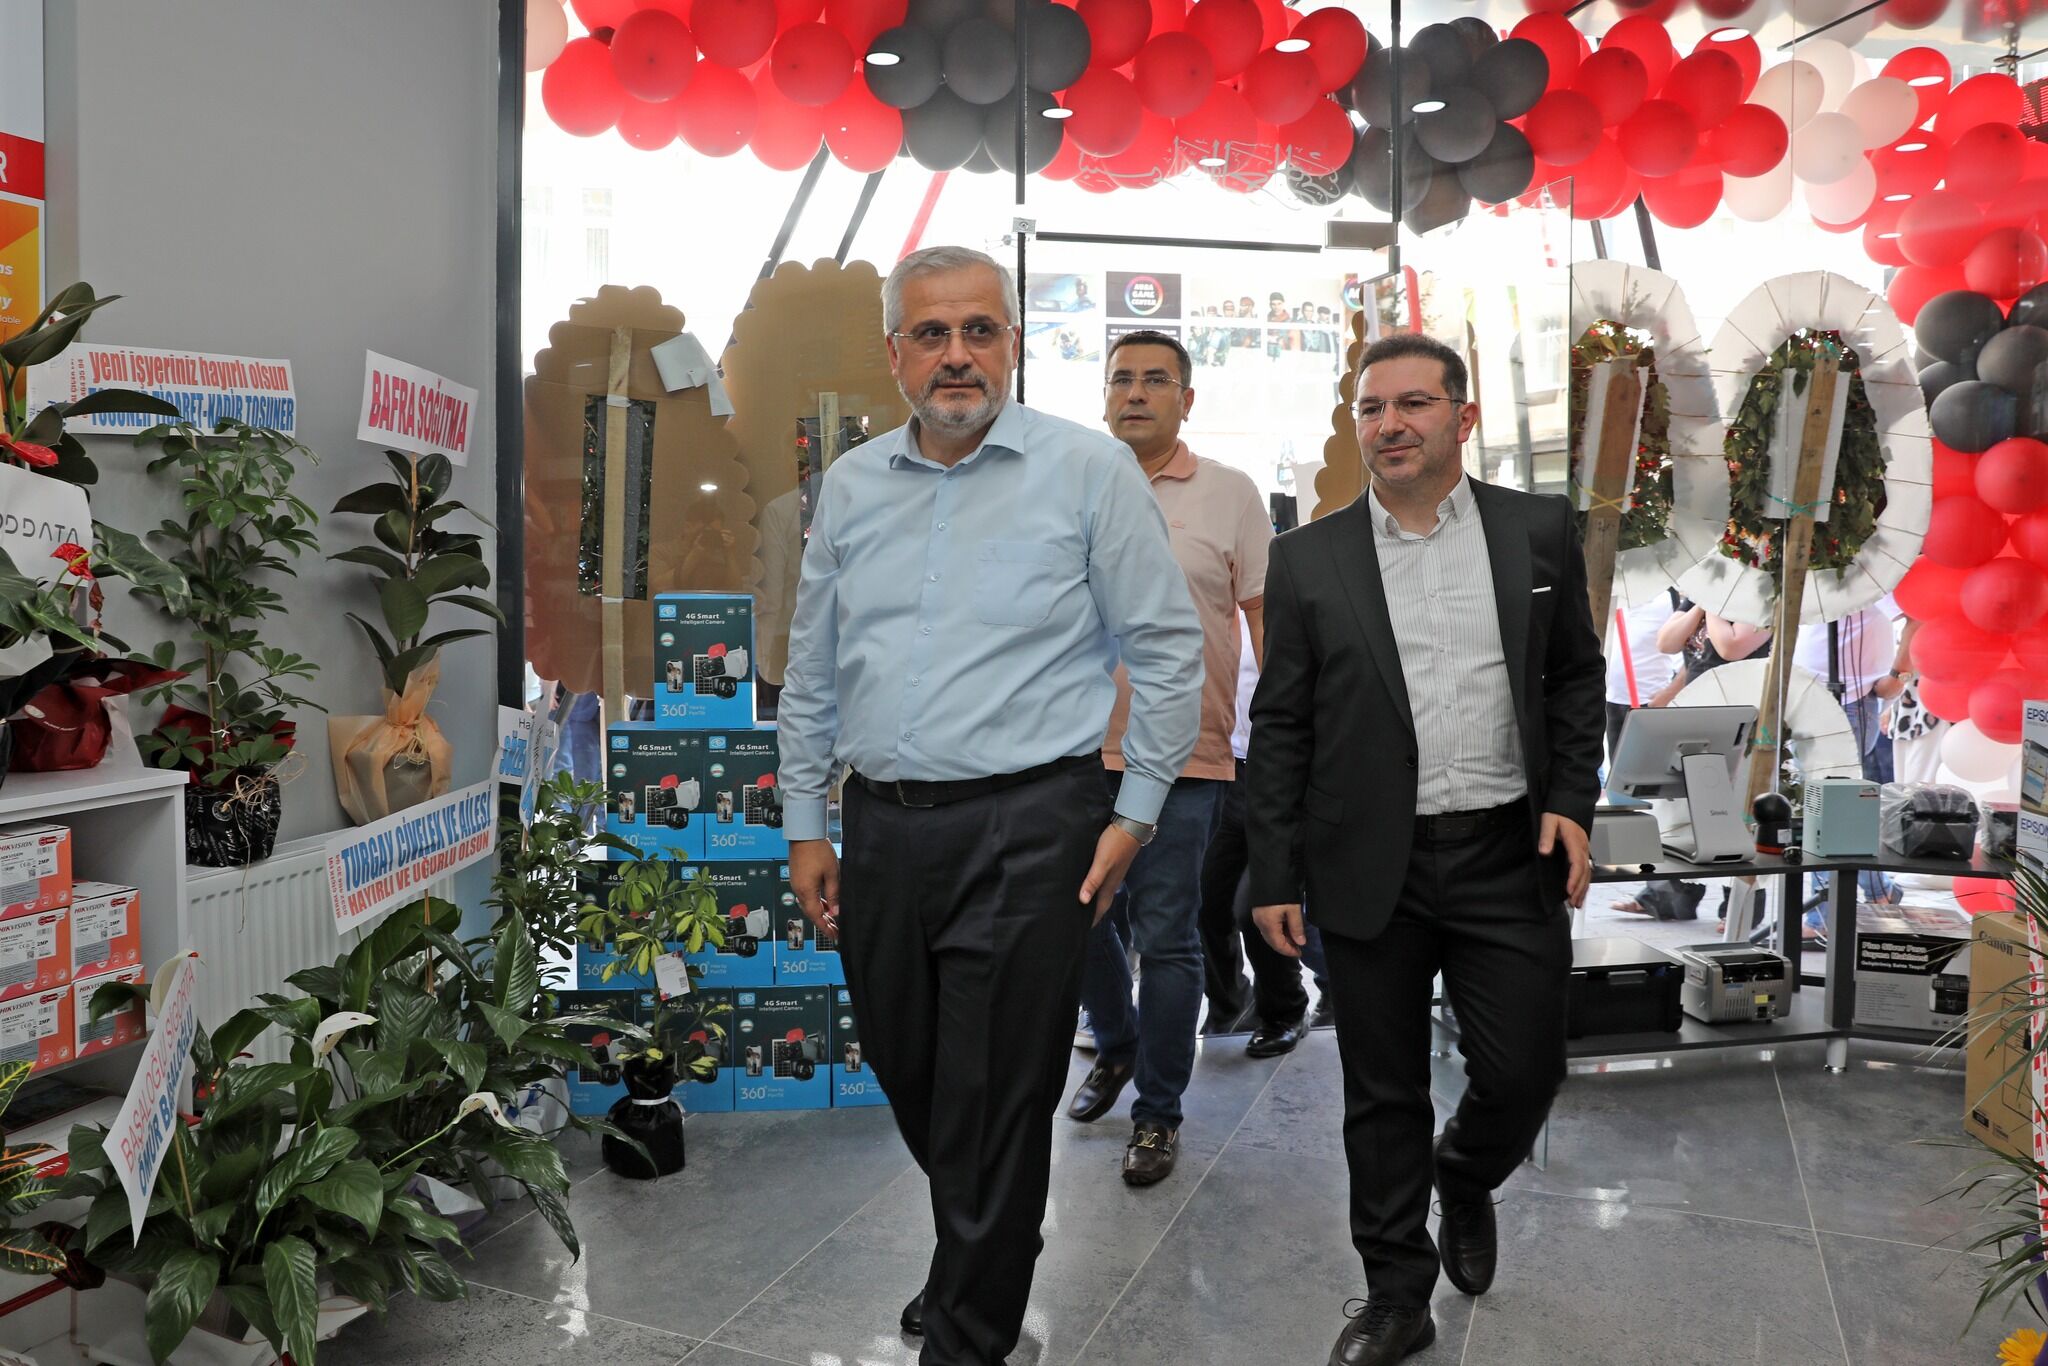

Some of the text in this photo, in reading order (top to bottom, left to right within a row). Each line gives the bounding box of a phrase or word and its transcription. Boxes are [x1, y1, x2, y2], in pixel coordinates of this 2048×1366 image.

[89, 350, 289, 391] yeni işyeriniz hayırlı olsun
[368, 369, 415, 437] BAFRA
[245, 394, 294, 431] TOSUNER
[341, 830, 394, 892] TURGAY
[443, 803, 460, 846] VE
[459, 784, 492, 841] AİLESİ
[348, 875, 394, 917] HAYIRLI
[396, 866, 411, 891] VE
[413, 850, 457, 883] UĞURLU
[458, 830, 489, 862] OLSUN
[1979, 930, 2013, 957] Canon
[121, 1032, 169, 1174] BAŞALOĞLU
[138, 1113, 164, 1197] ÖMÜR
